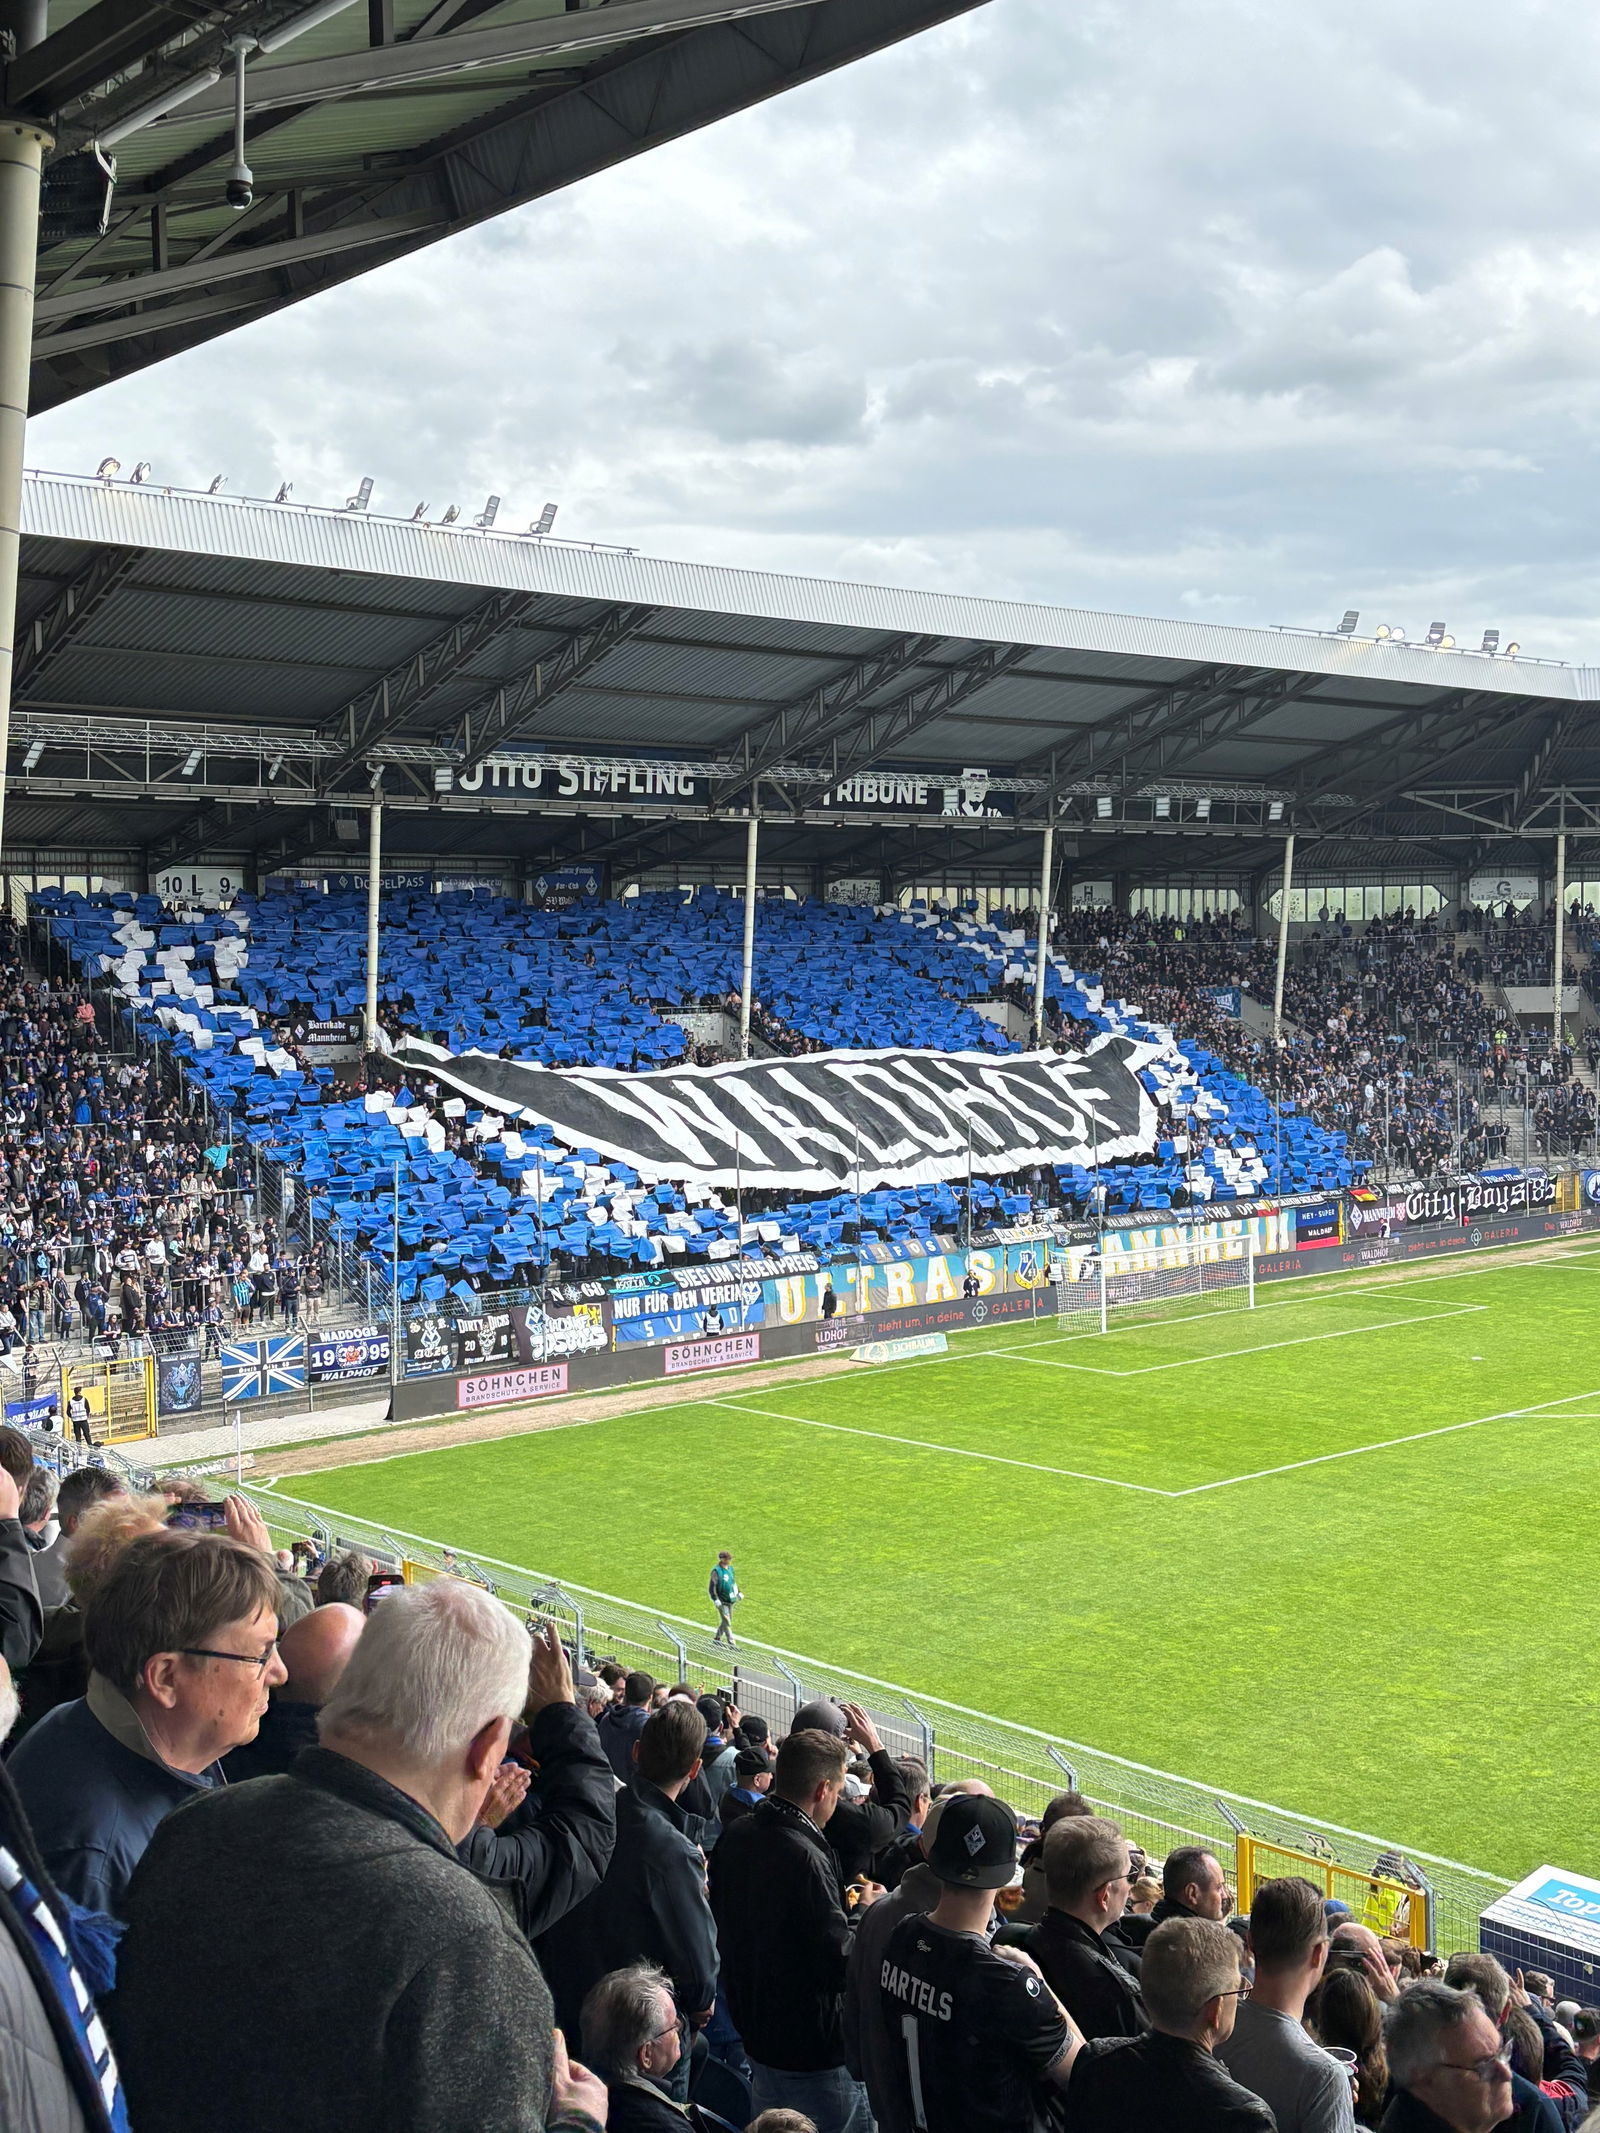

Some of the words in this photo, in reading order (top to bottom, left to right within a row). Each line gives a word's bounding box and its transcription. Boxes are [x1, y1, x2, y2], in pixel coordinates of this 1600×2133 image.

[458, 760, 542, 791] OTTO
[557, 758, 695, 796] SIFFLING
[162, 876, 183, 894] 10
[191, 874, 204, 896] L
[219, 876, 231, 894] 9
[354, 875, 424, 890] DOPELPASS
[307, 1020, 346, 1030] Barrikade
[306, 1033, 347, 1043] Mannheim
[560, 1060, 1121, 1166] WALDHOF
[1484, 1227, 1519, 1241] GALERIA
[861, 1241, 951, 1260] TIFOSI
[1361, 1247, 1389, 1260] WALDHOF
[673, 1269, 709, 1289] SIEG
[705, 1264, 732, 1282] UM
[734, 1259, 781, 1280] JEDEN
[779, 1254, 820, 1274] PREIS
[1259, 1259, 1302, 1274] GALERIA
[774, 1251, 998, 1324] ULTRAS
[614, 1299, 641, 1320] NUR
[645, 1291, 669, 1314] FÜR
[674, 1290, 698, 1311] DEN
[701, 1284, 743, 1306] VEREIN
[878, 1319, 902, 1333] zieht
[926, 1313, 935, 1325] in
[937, 1310, 965, 1322] deine
[991, 1297, 1044, 1315] GALERA
[319, 1326, 379, 1343] MADDOGS
[457, 1318, 484, 1334] DIRTY
[311, 1349, 336, 1368] 19
[369, 1343, 391, 1361] 95
[465, 1341, 476, 1352] 20
[671, 1337, 753, 1361] SÖHNCHEN
[671, 1356, 717, 1369] BRANDSCHUTZ
[726, 1350, 753, 1360] SERVICE
[321, 1367, 379, 1382] WALDHOF
[466, 1368, 561, 1394] SÖHNCHEN
[465, 1388, 520, 1403] BRANDSCHUTZ
[529, 1381, 561, 1393] SERVICE
[880, 1959, 953, 2022] BARTELS
